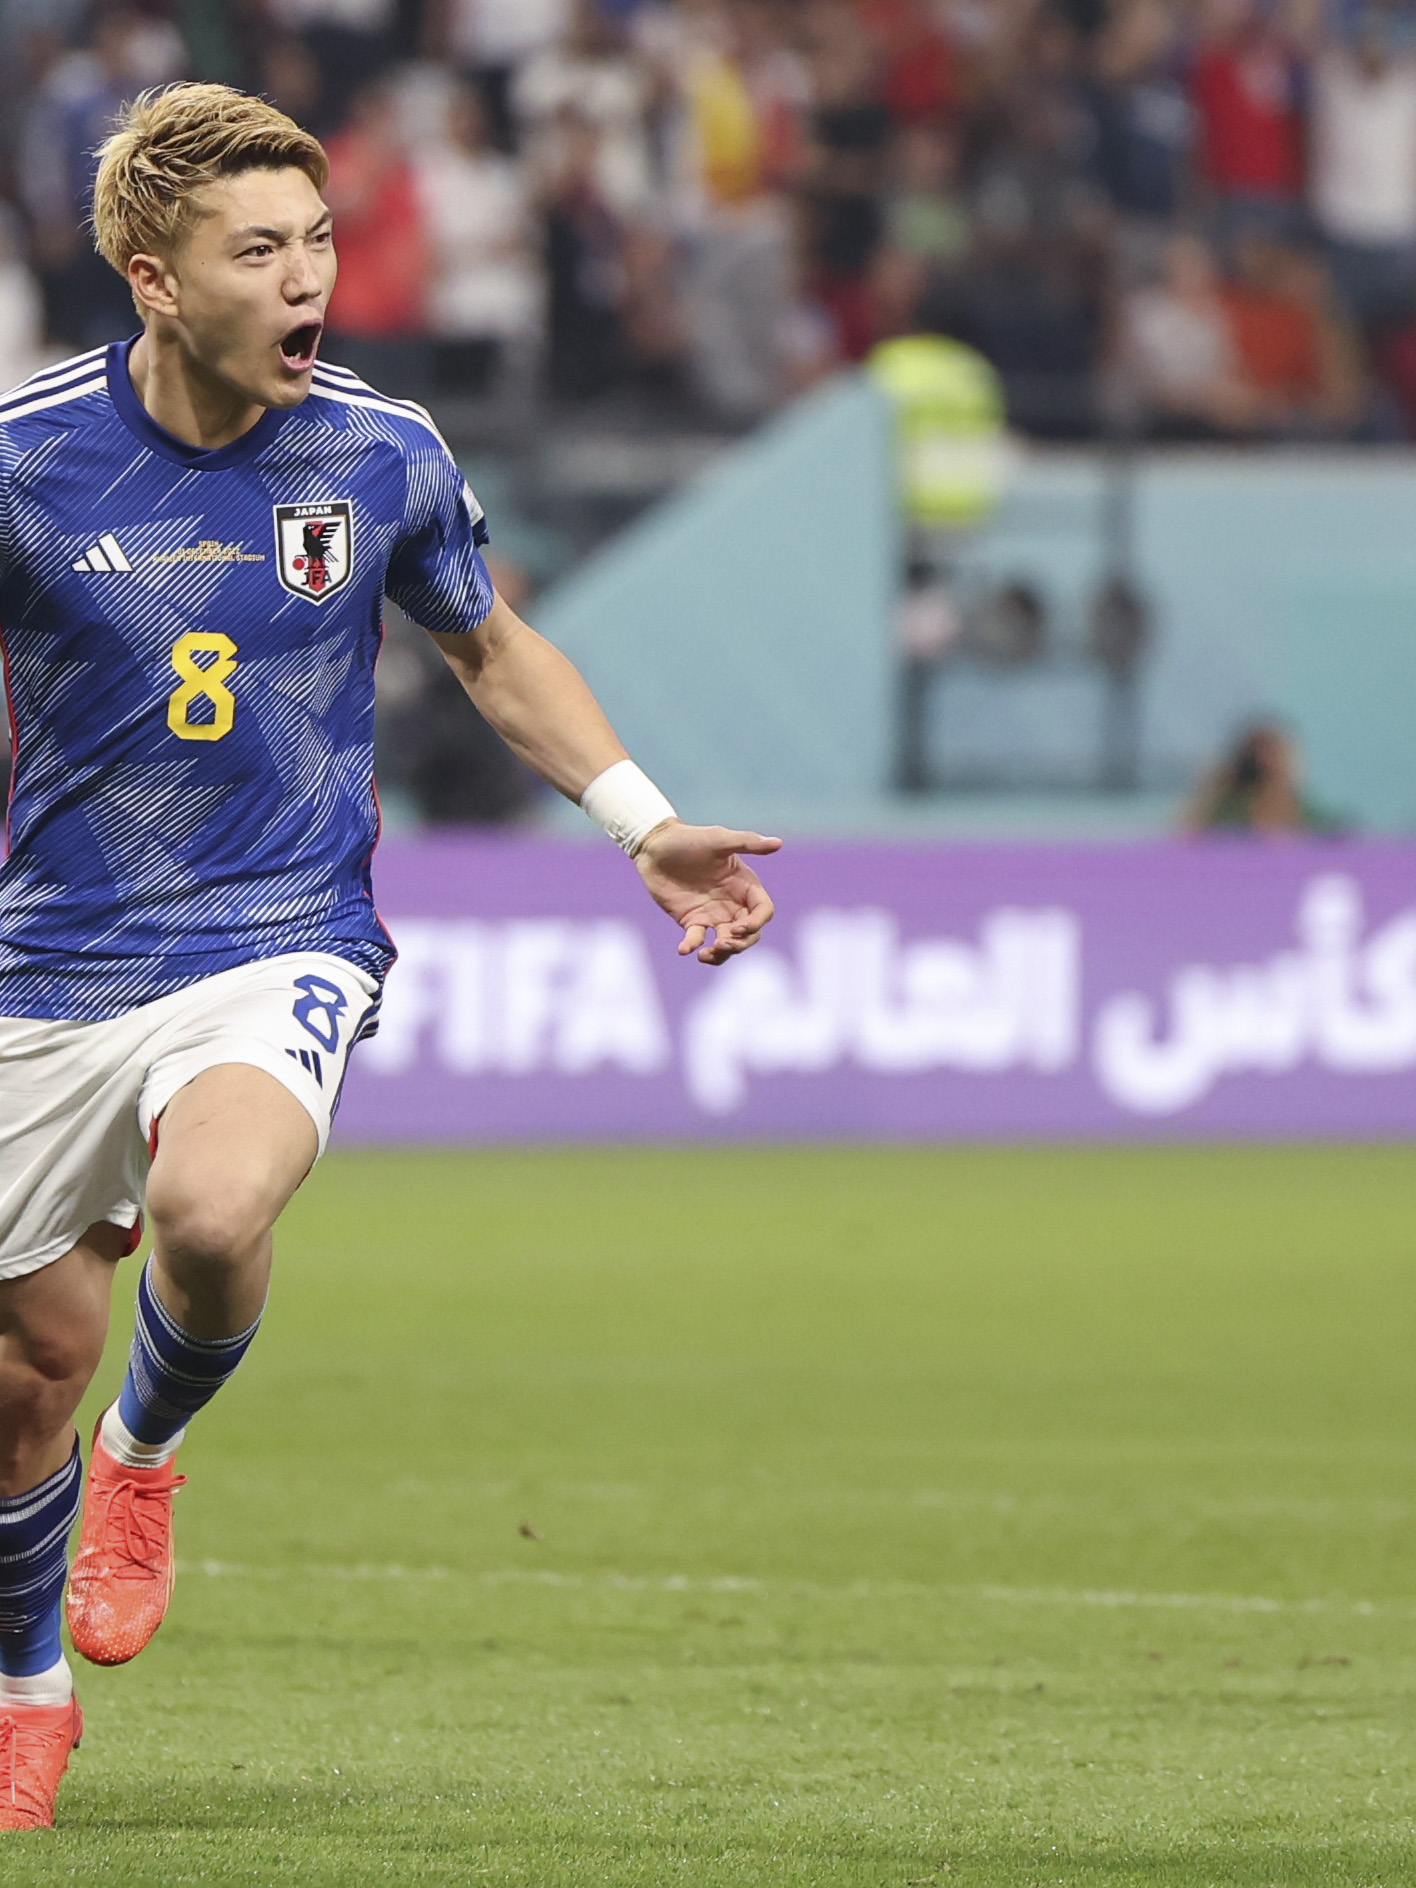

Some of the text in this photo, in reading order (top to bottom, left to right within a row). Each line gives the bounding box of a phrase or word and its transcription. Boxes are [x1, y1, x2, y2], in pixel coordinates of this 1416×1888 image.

[293, 506, 332, 517] JAPAN
[166, 631, 239, 742] 8
[292, 974, 348, 1054] 8
[364, 919, 670, 1072] FIFA
